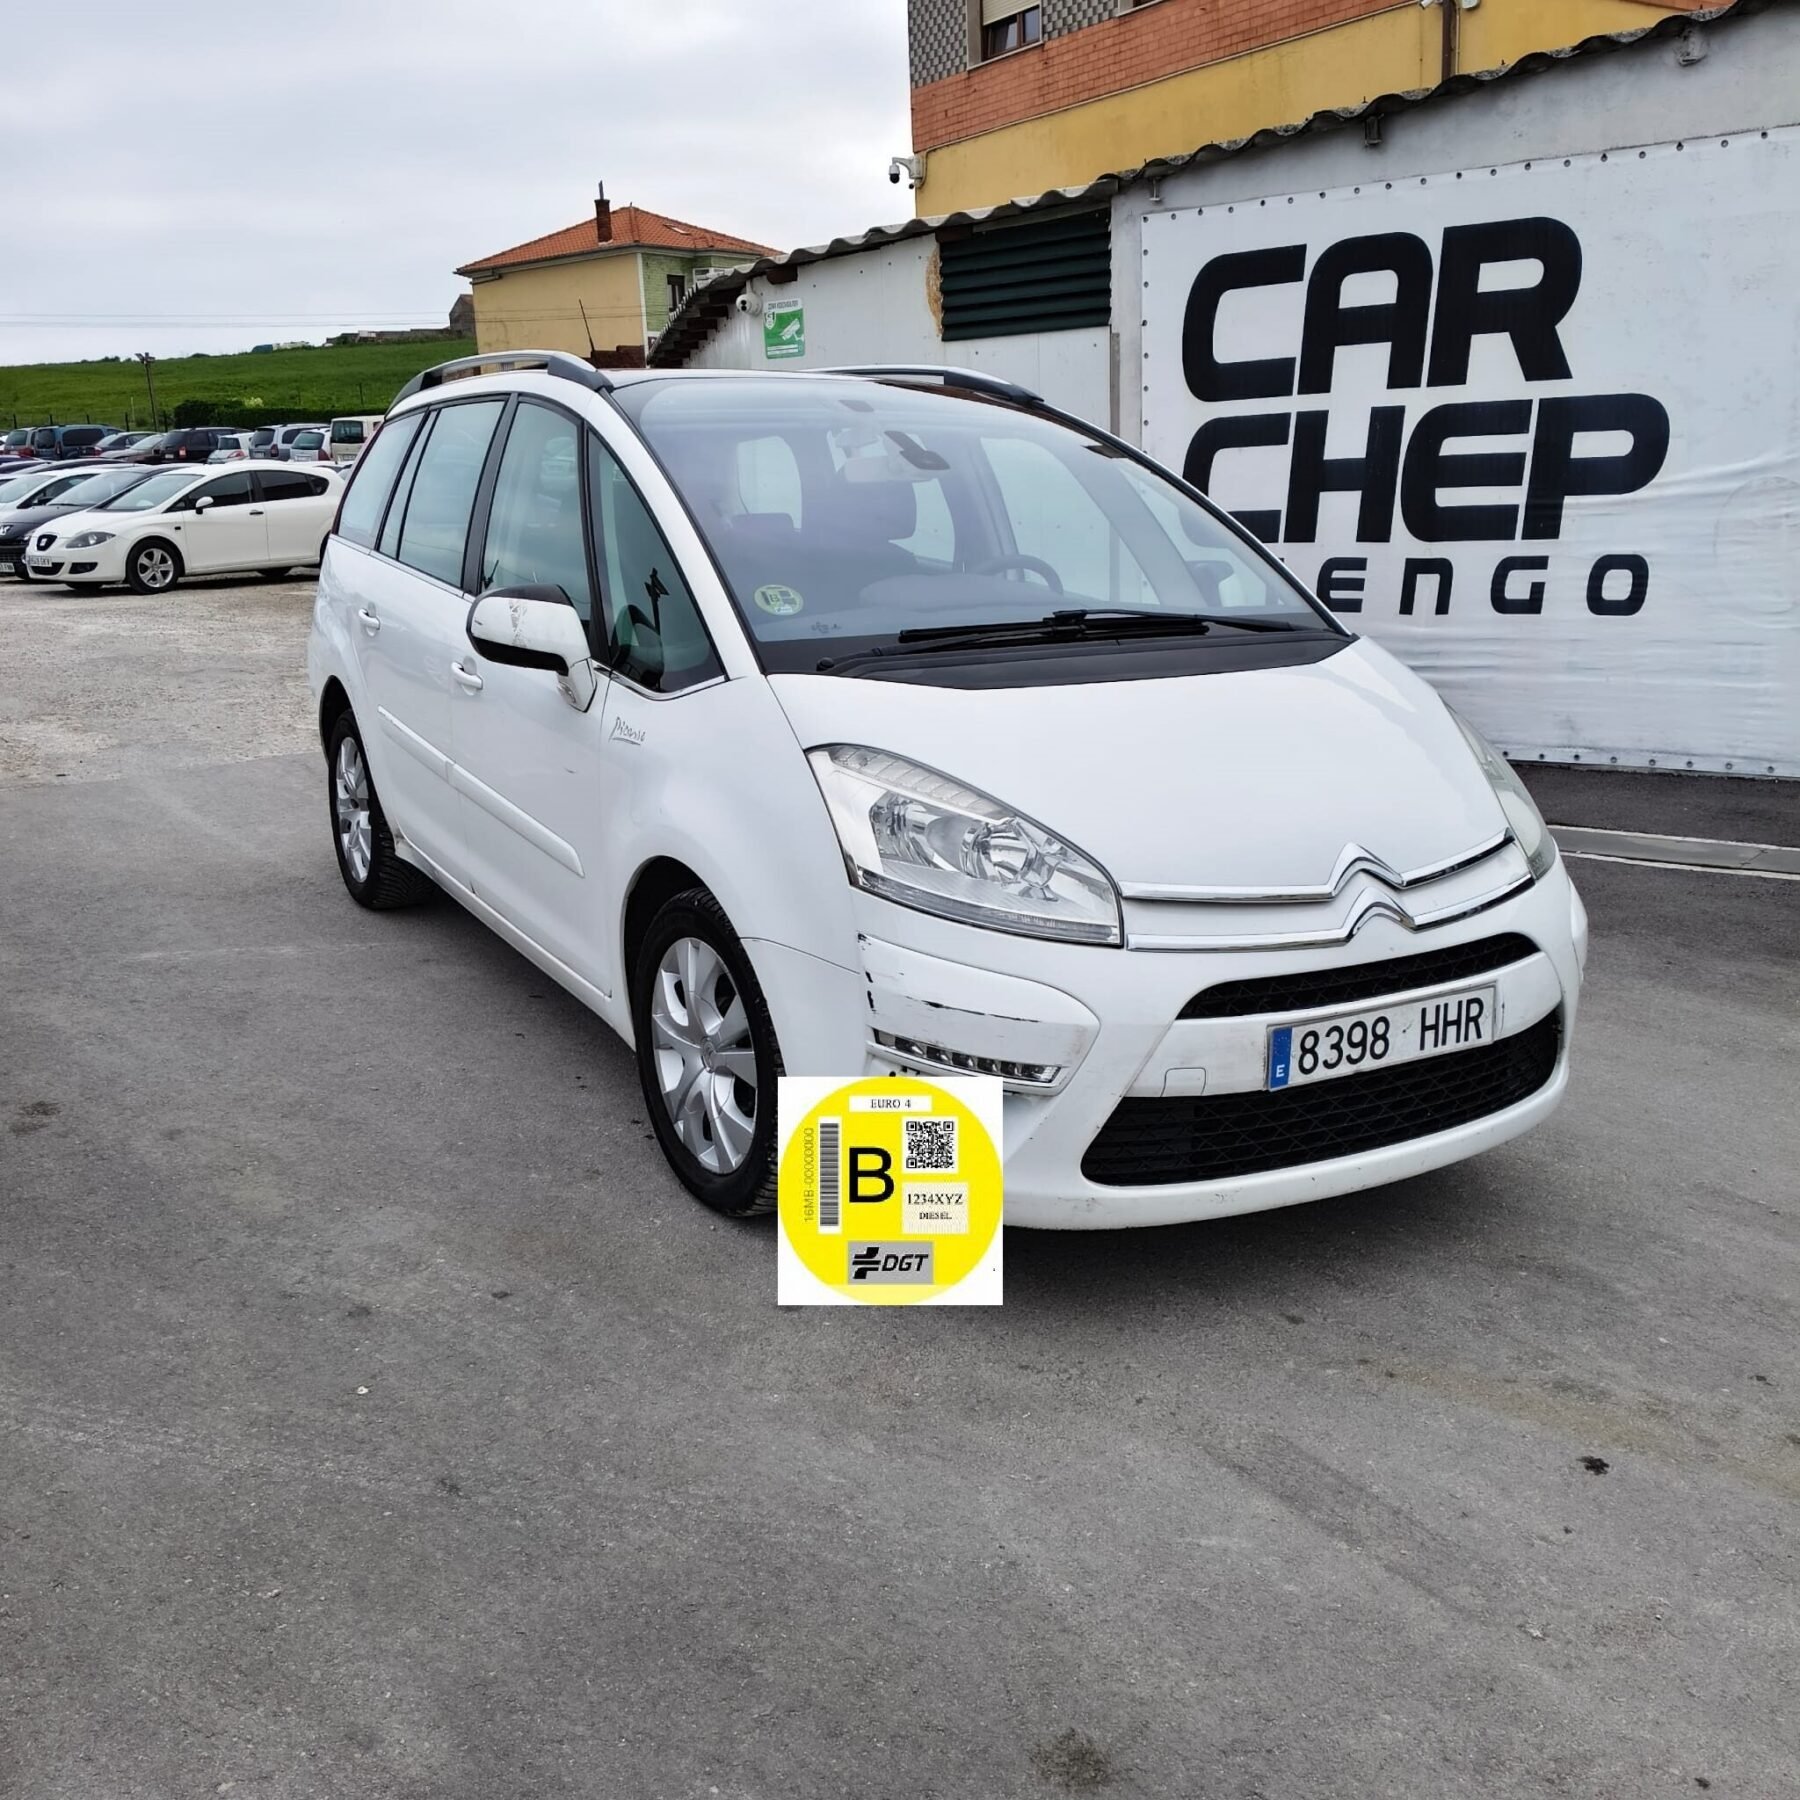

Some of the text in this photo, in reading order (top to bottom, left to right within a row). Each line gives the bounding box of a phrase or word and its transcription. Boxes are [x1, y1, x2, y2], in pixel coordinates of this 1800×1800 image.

[1182, 216, 1582, 402] CAR
[1182, 393, 1670, 543] CHEP
[1279, 554, 1649, 616] ENGO
[1276, 997, 1484, 1078] E 8398 HHR
